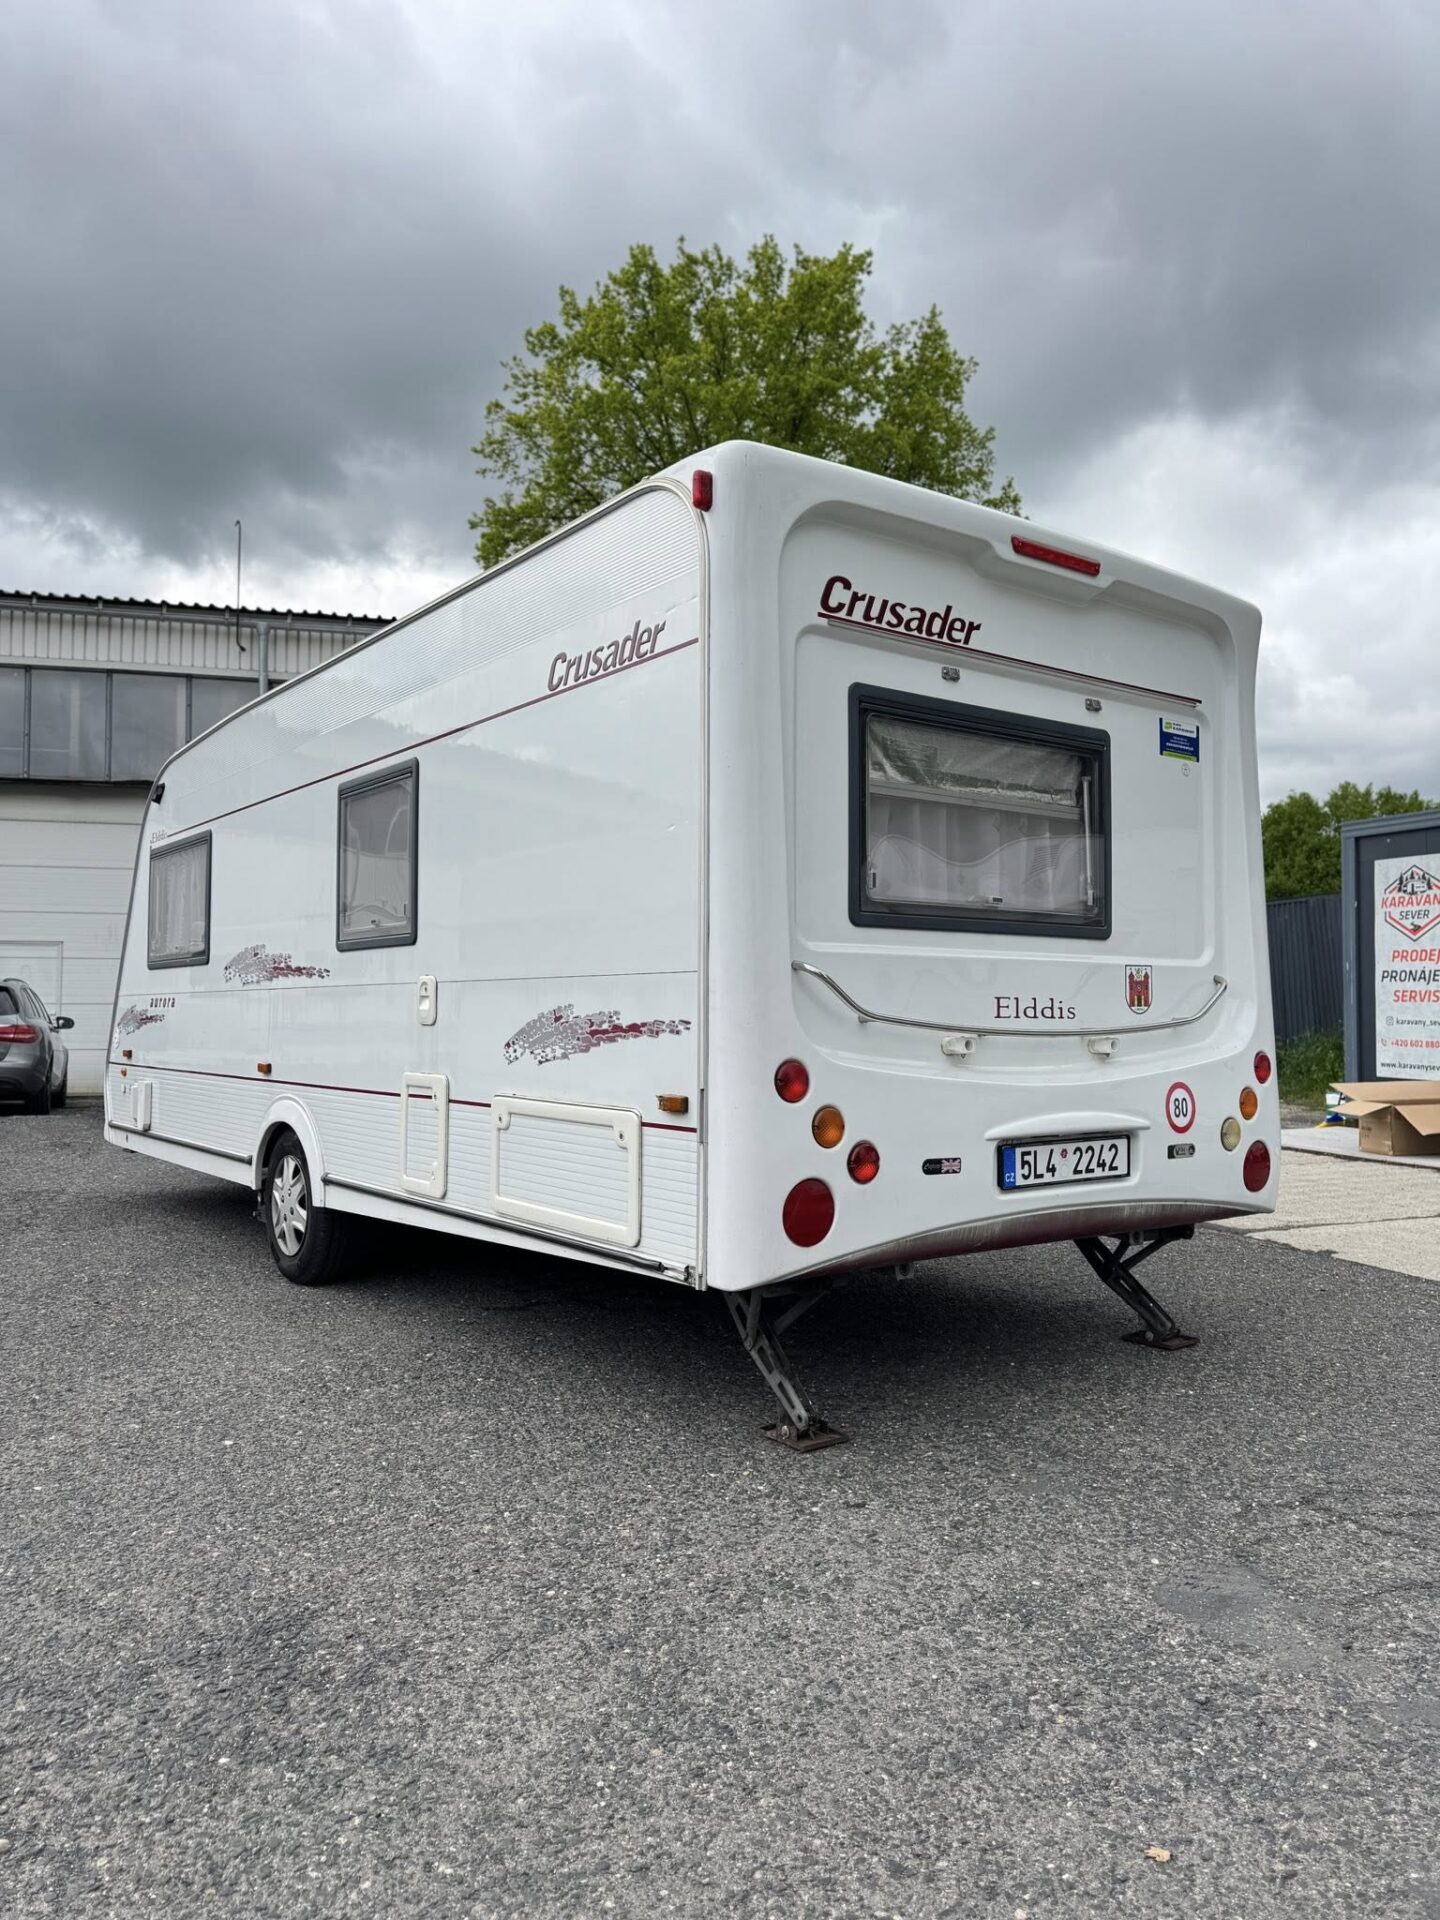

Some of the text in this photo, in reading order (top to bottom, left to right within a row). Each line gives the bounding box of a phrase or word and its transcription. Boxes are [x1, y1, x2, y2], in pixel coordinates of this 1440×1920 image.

[820, 575, 982, 646] Crusader
[547, 619, 667, 692] Crusader
[1399, 909, 1430, 920] SEVER
[150, 997, 175, 1008] aurora
[1393, 989, 1440, 1003] SERVIS
[994, 996, 1076, 1020] Elddis
[1391, 1039, 1408, 1047] +420
[1410, 1039, 1423, 1047] 602
[1174, 1097, 1188, 1118] 80
[1020, 1143, 1119, 1180] 5L4 2242
[1005, 1173, 1015, 1182] CZ
